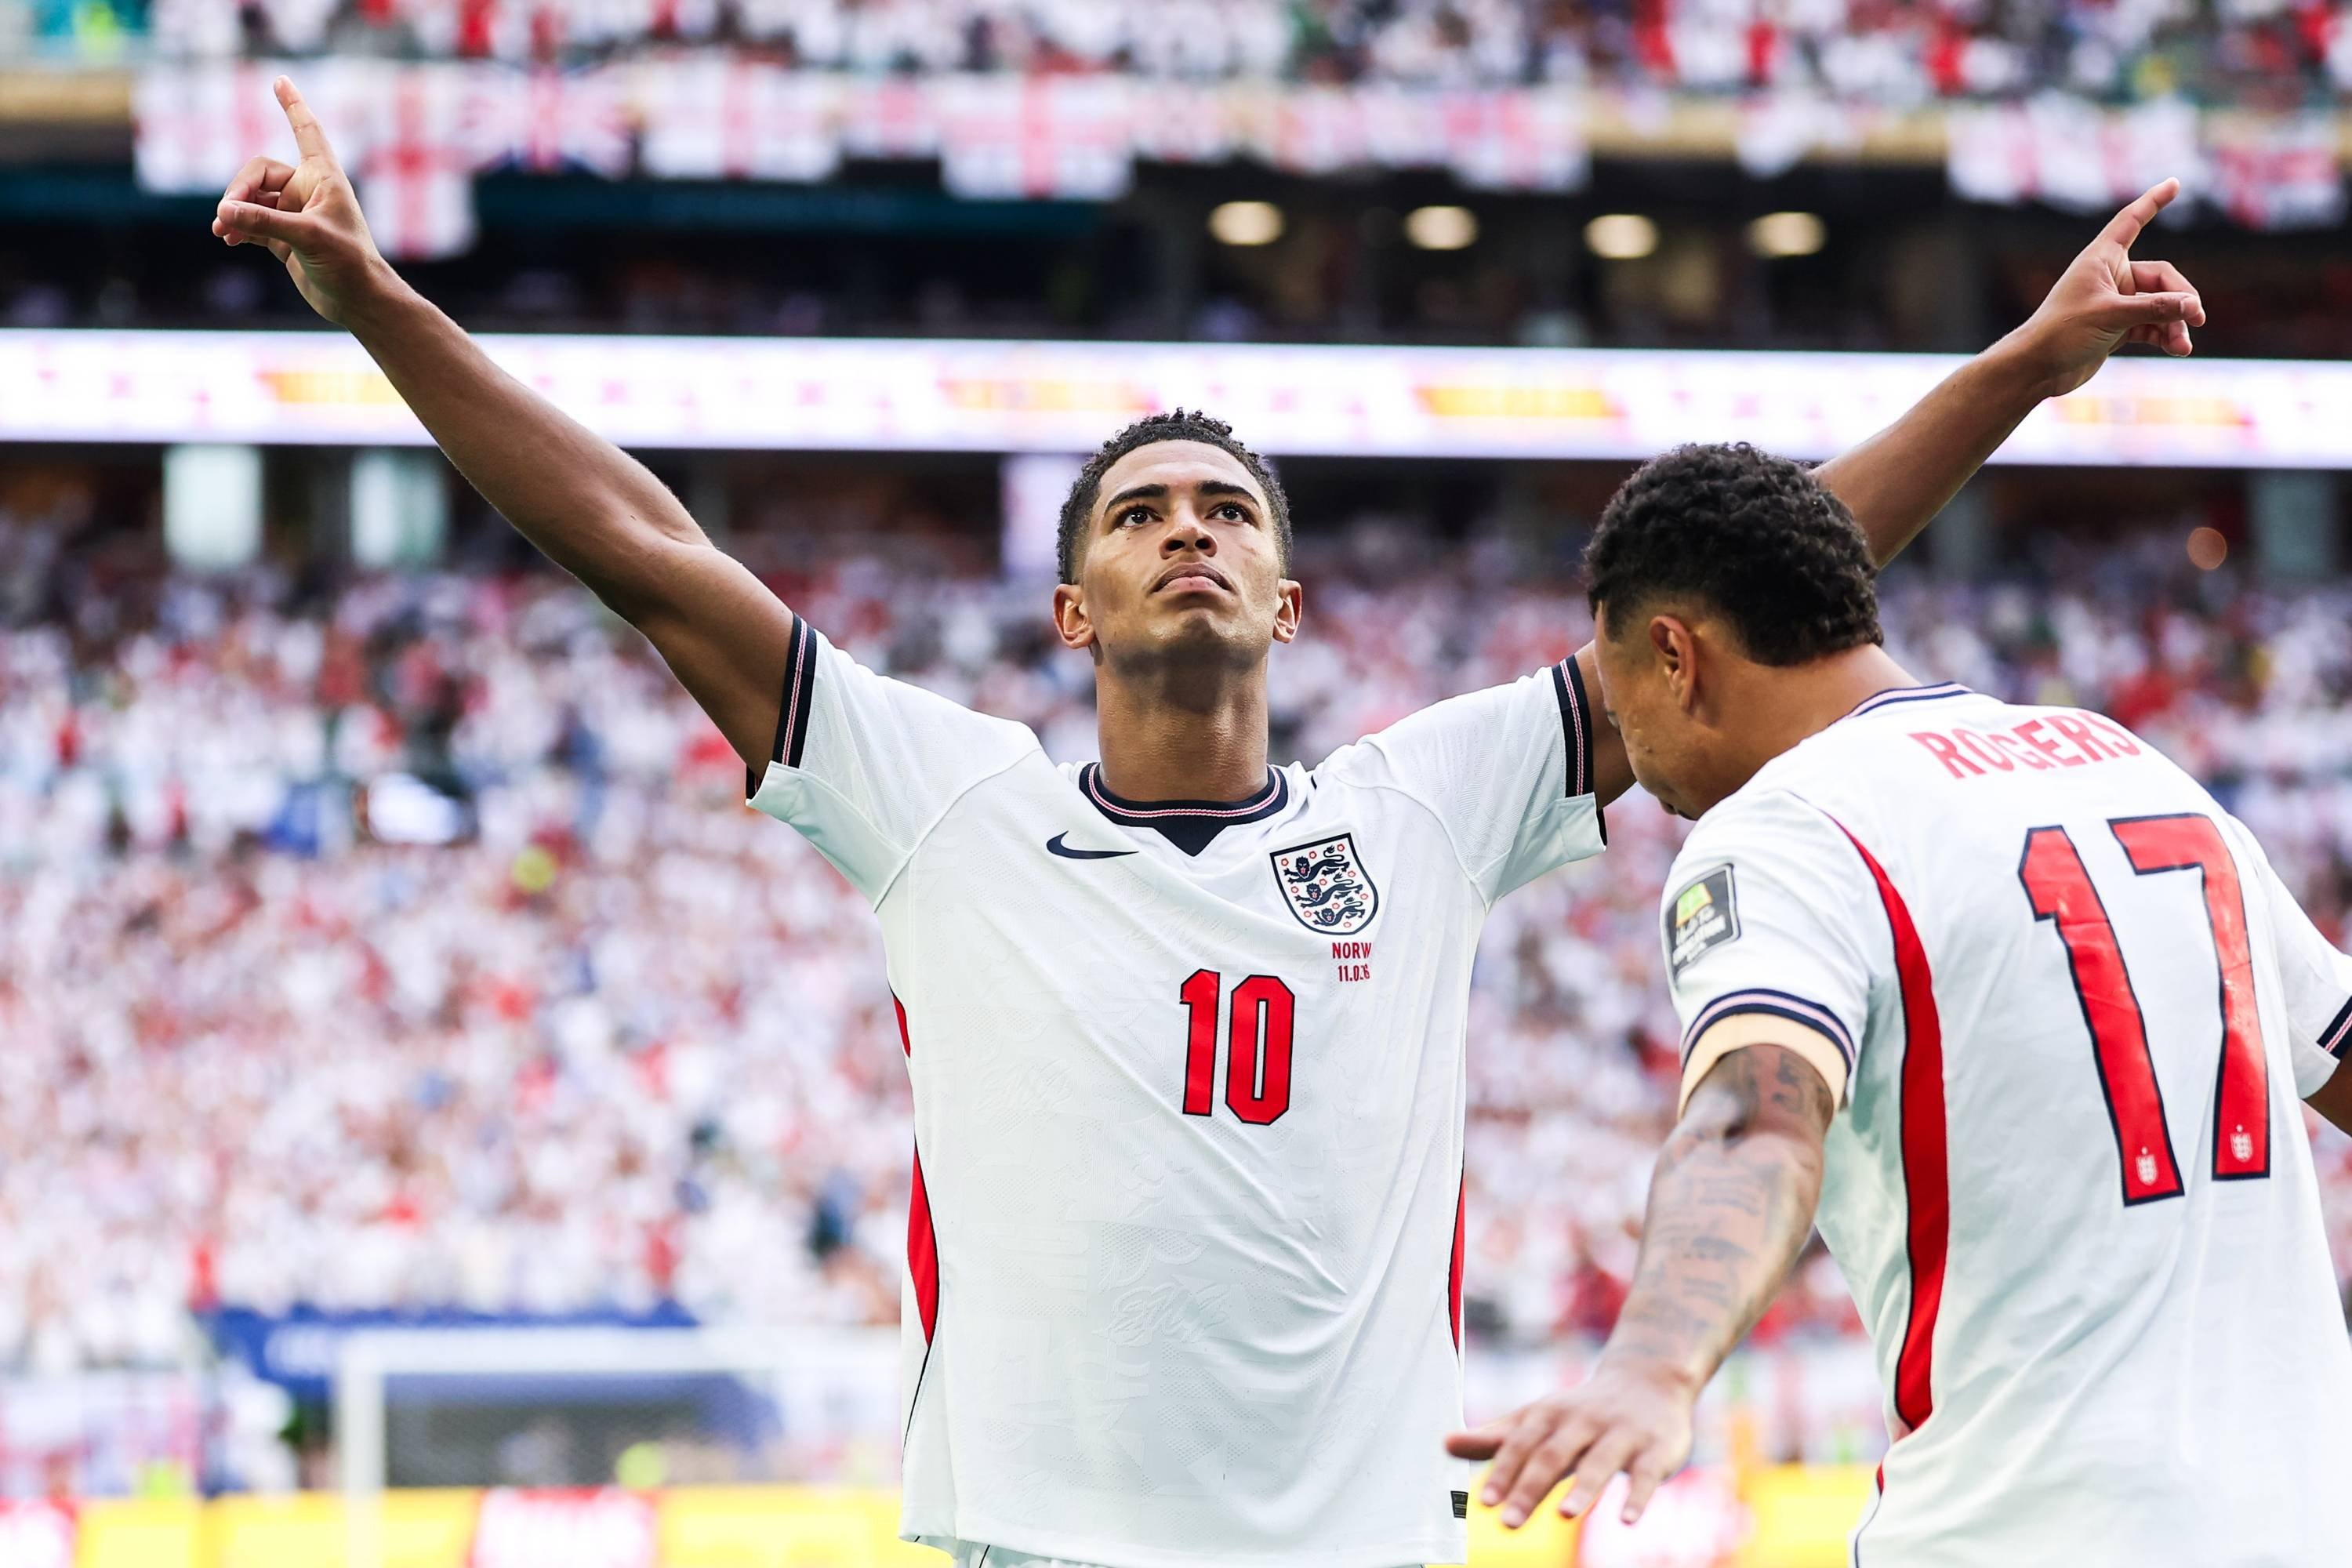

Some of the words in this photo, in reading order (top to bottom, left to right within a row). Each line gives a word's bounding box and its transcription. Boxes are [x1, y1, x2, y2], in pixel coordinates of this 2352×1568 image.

[1907, 712, 2141, 779] ROGERS
[1179, 968, 1295, 1126] 10
[2018, 812, 2270, 1207] 17
